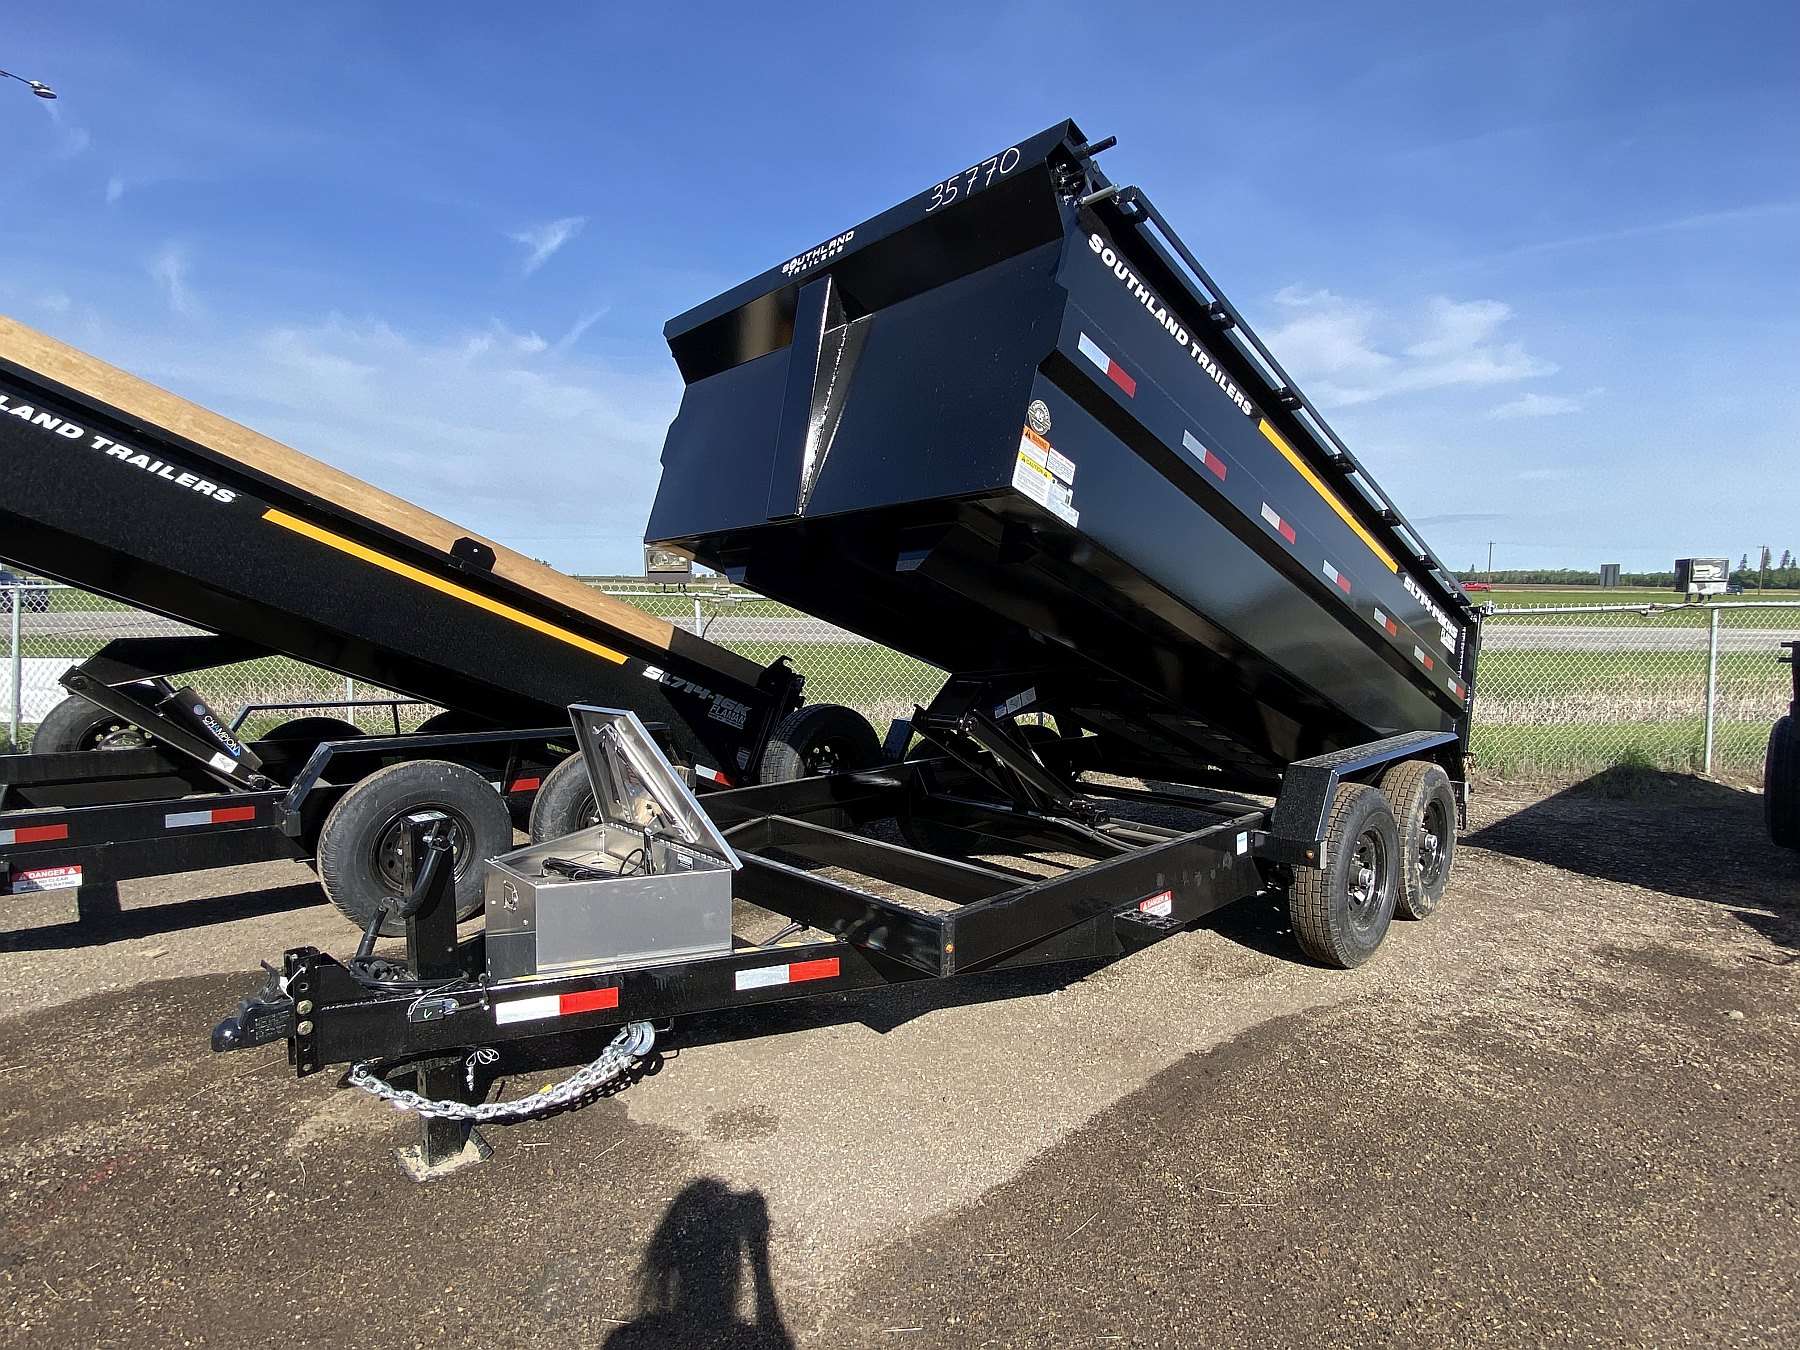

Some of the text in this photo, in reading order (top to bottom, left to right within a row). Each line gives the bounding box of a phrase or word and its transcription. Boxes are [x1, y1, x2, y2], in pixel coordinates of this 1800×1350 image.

[925, 147, 1020, 212] 35770
[781, 231, 855, 274] SOUTHLAND
[788, 245, 844, 277] TRAILERS
[1088, 233, 1253, 416] SOUTHLAND TRAILERS
[91, 435, 237, 504] TRAILERS
[204, 715, 240, 751] CHAMPION
[710, 704, 747, 724] FLAMAN
[28, 868, 66, 879] DANGER
